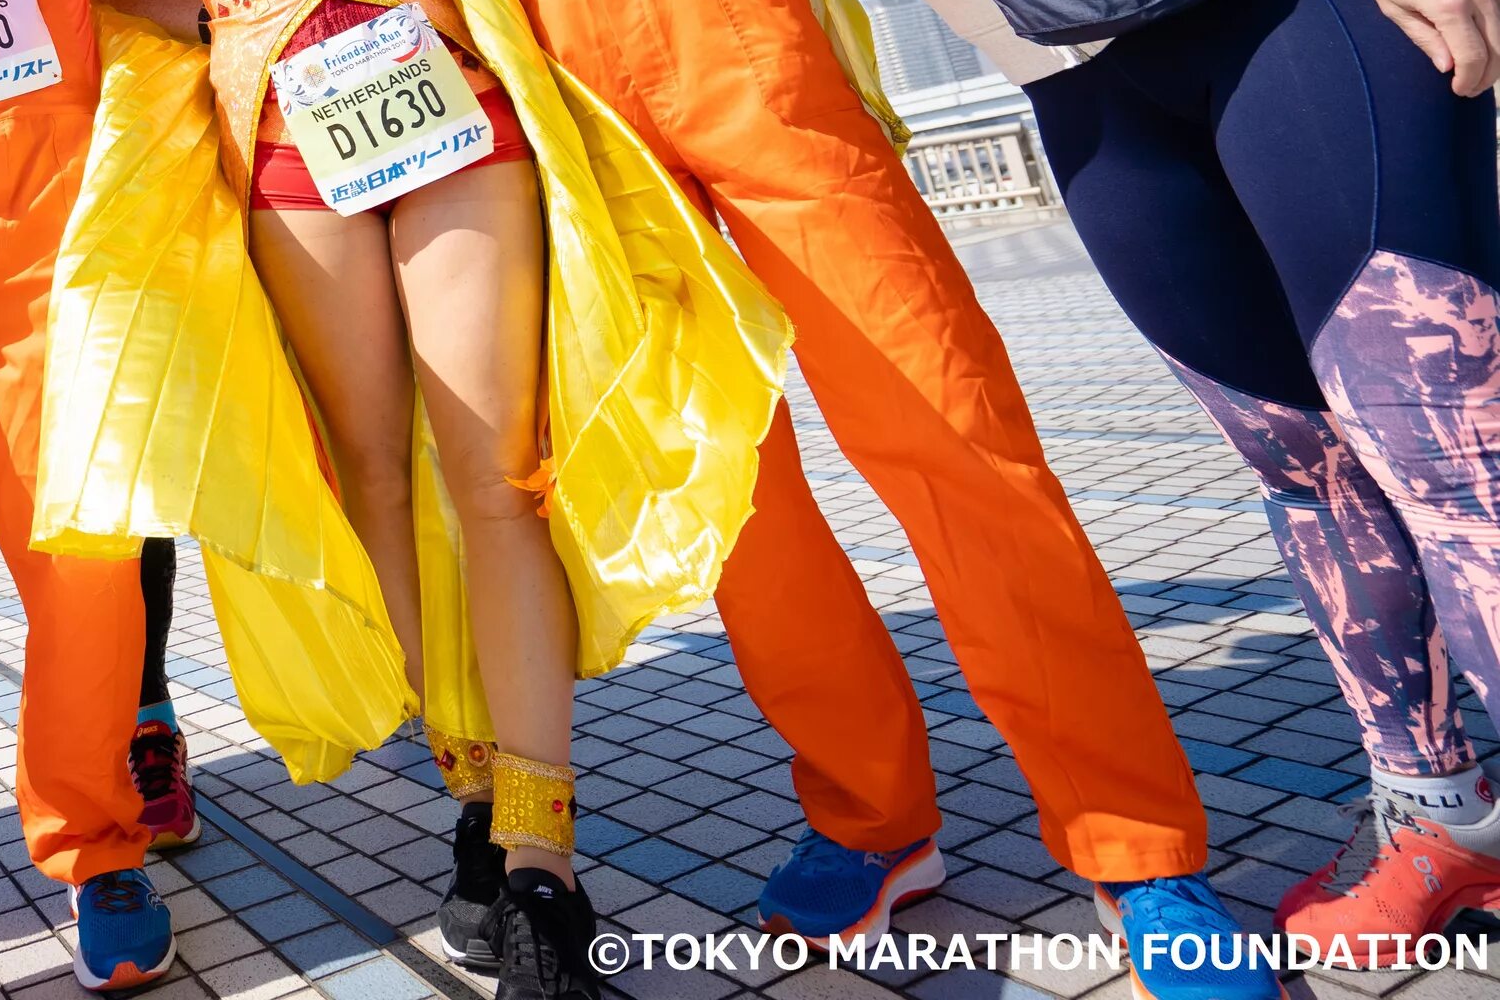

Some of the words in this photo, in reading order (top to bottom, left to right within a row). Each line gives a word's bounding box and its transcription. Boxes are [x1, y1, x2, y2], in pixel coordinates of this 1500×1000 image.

[323, 37, 380, 70] Friendship
[379, 30, 402, 47] Run
[331, 63, 355, 79] TOKYO
[355, 47, 392, 68] MARATHON
[391, 39, 407, 51] 2019
[311, 58, 431, 123] NETHERLANDS
[326, 79, 446, 161] D1630
[330, 124, 487, 204] 近畿日本ツーリスト
